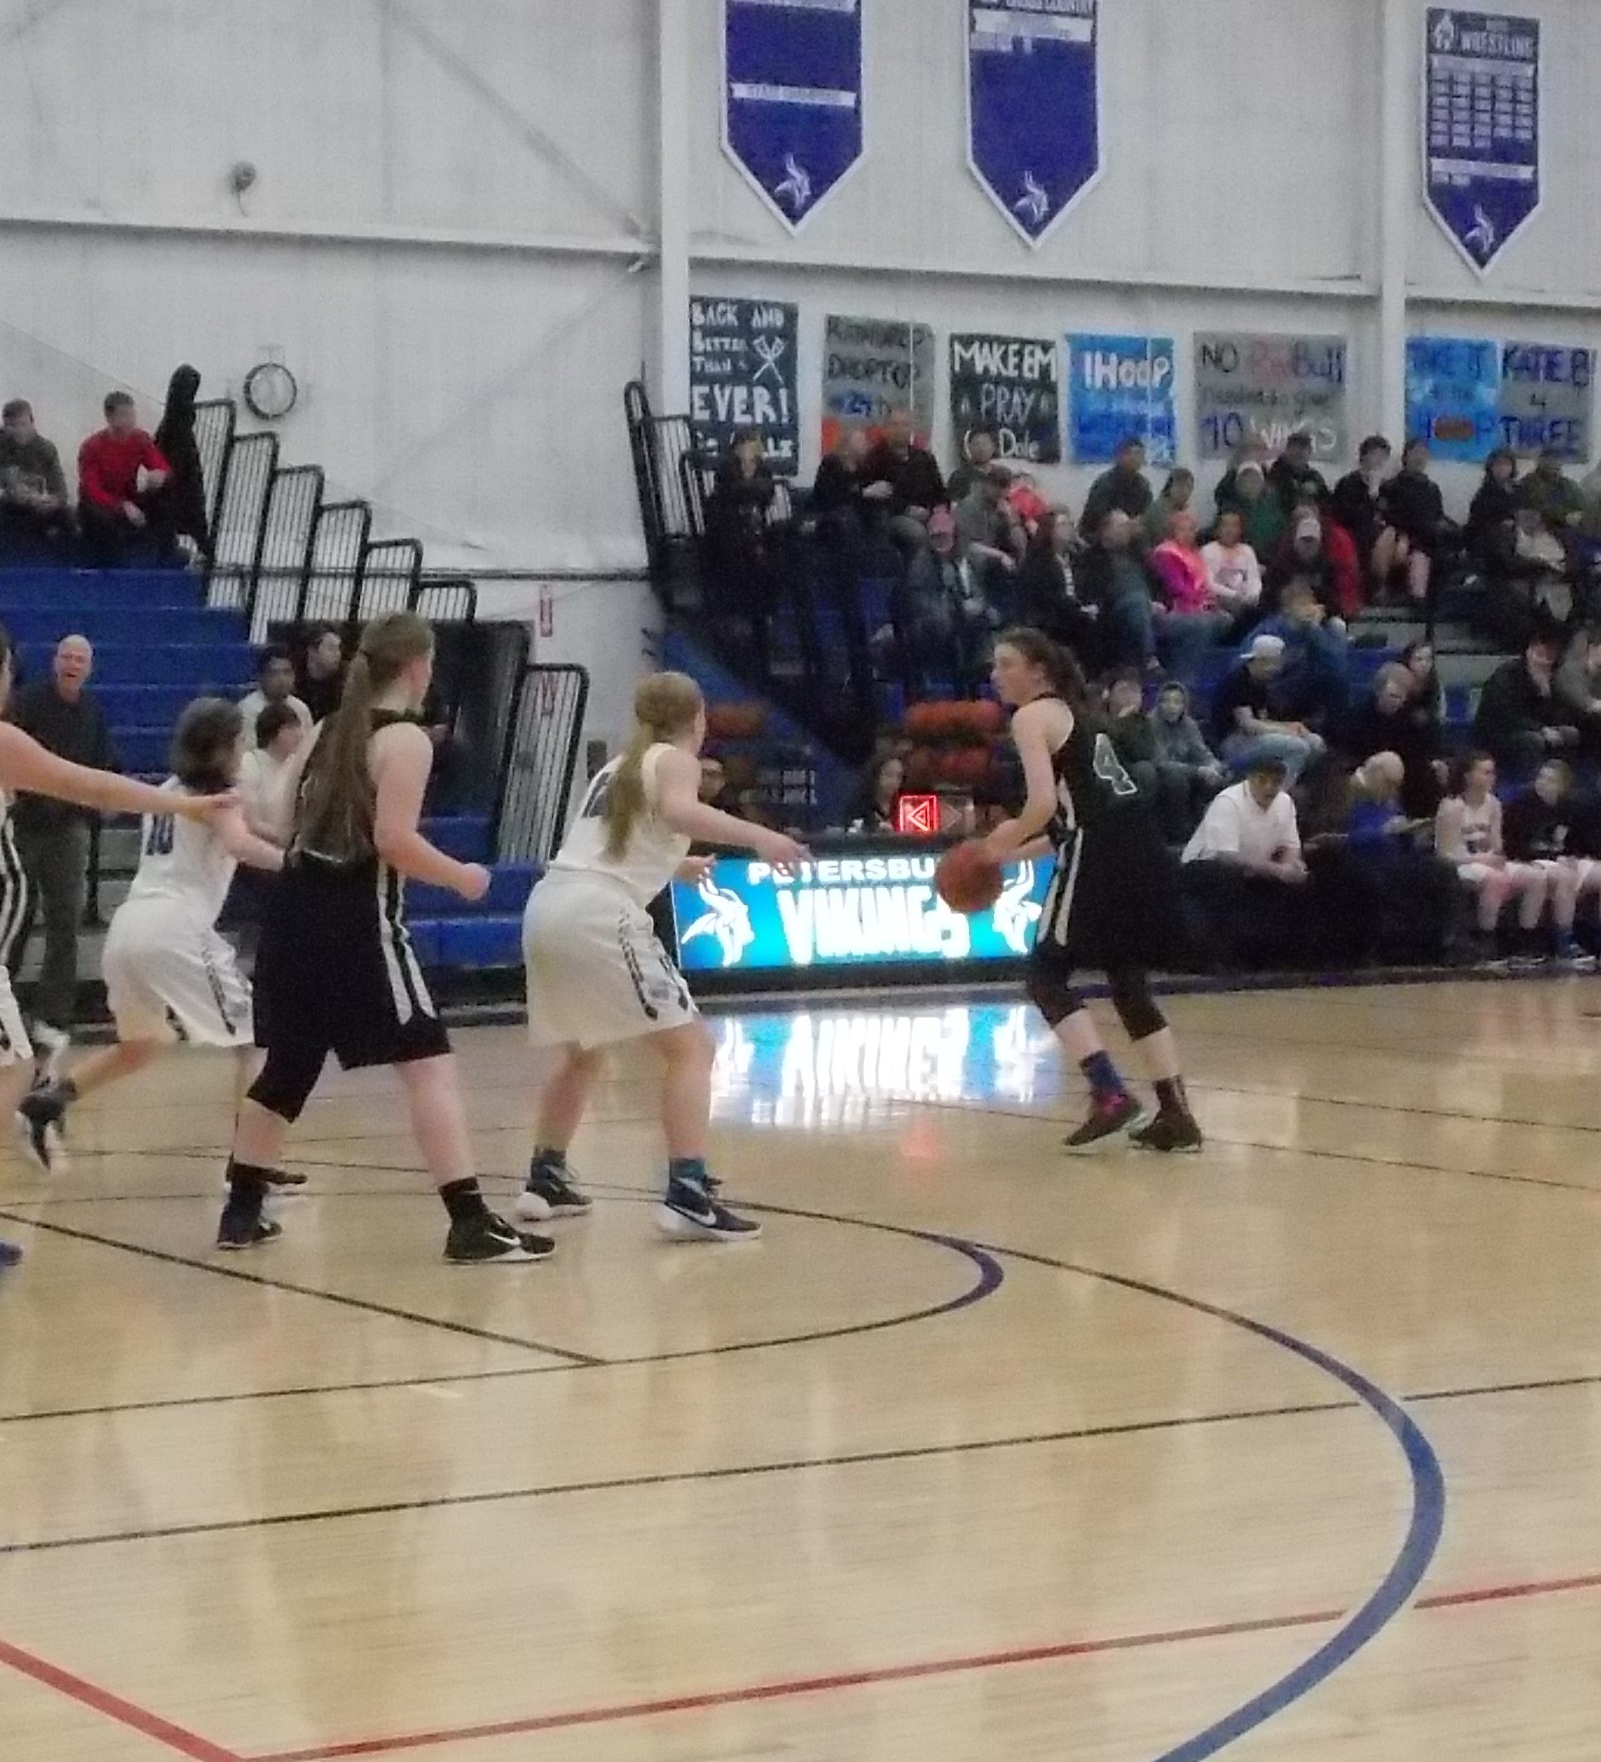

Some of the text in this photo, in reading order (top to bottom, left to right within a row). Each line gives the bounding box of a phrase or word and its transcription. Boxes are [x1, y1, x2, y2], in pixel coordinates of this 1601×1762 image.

[692, 303, 785, 328] BACK AND
[954, 341, 1019, 378] MAKE
[1202, 342, 1239, 374] NO
[692, 384, 789, 424] EVER!
[981, 384, 1035, 425] PRAY
[1201, 411, 1243, 450] 10
[1092, 732, 1138, 795] 4
[748, 857, 941, 885] PETERSBU
[776, 885, 970, 965] VIKINGS
